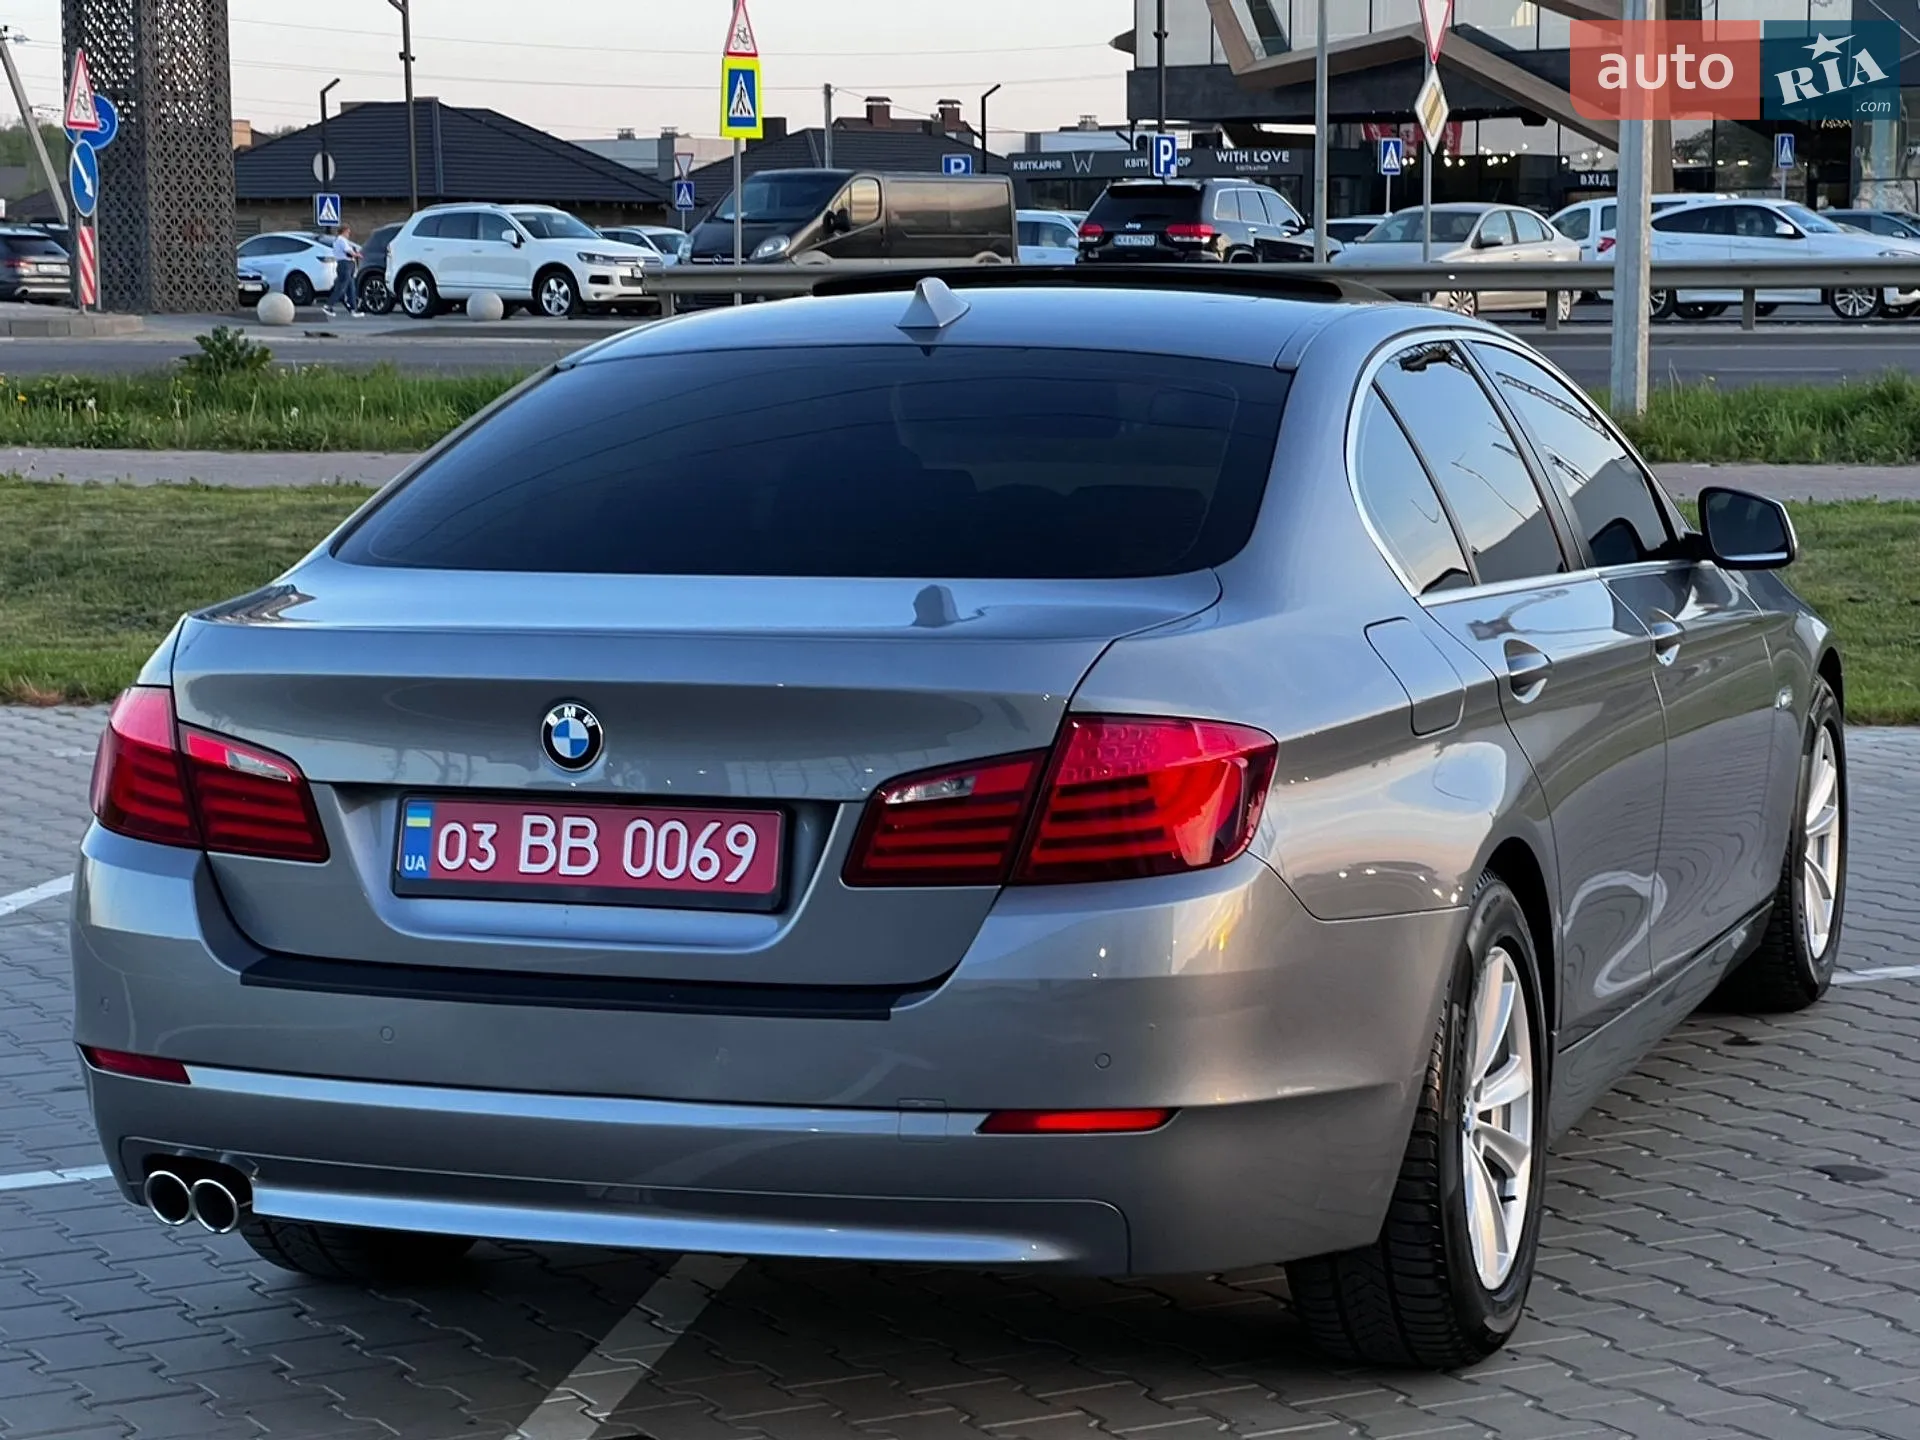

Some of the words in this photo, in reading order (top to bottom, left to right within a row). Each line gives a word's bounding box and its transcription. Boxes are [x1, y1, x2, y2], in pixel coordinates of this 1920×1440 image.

[1160, 139, 1172, 173] P
[1216, 150, 1248, 163] WITH
[1253, 150, 1290, 163] LOVE
[546, 706, 596, 728] BMW
[437, 822, 498, 871] 03
[518, 814, 600, 877] BB
[622, 818, 758, 884] 0069
[404, 854, 427, 872] UA
